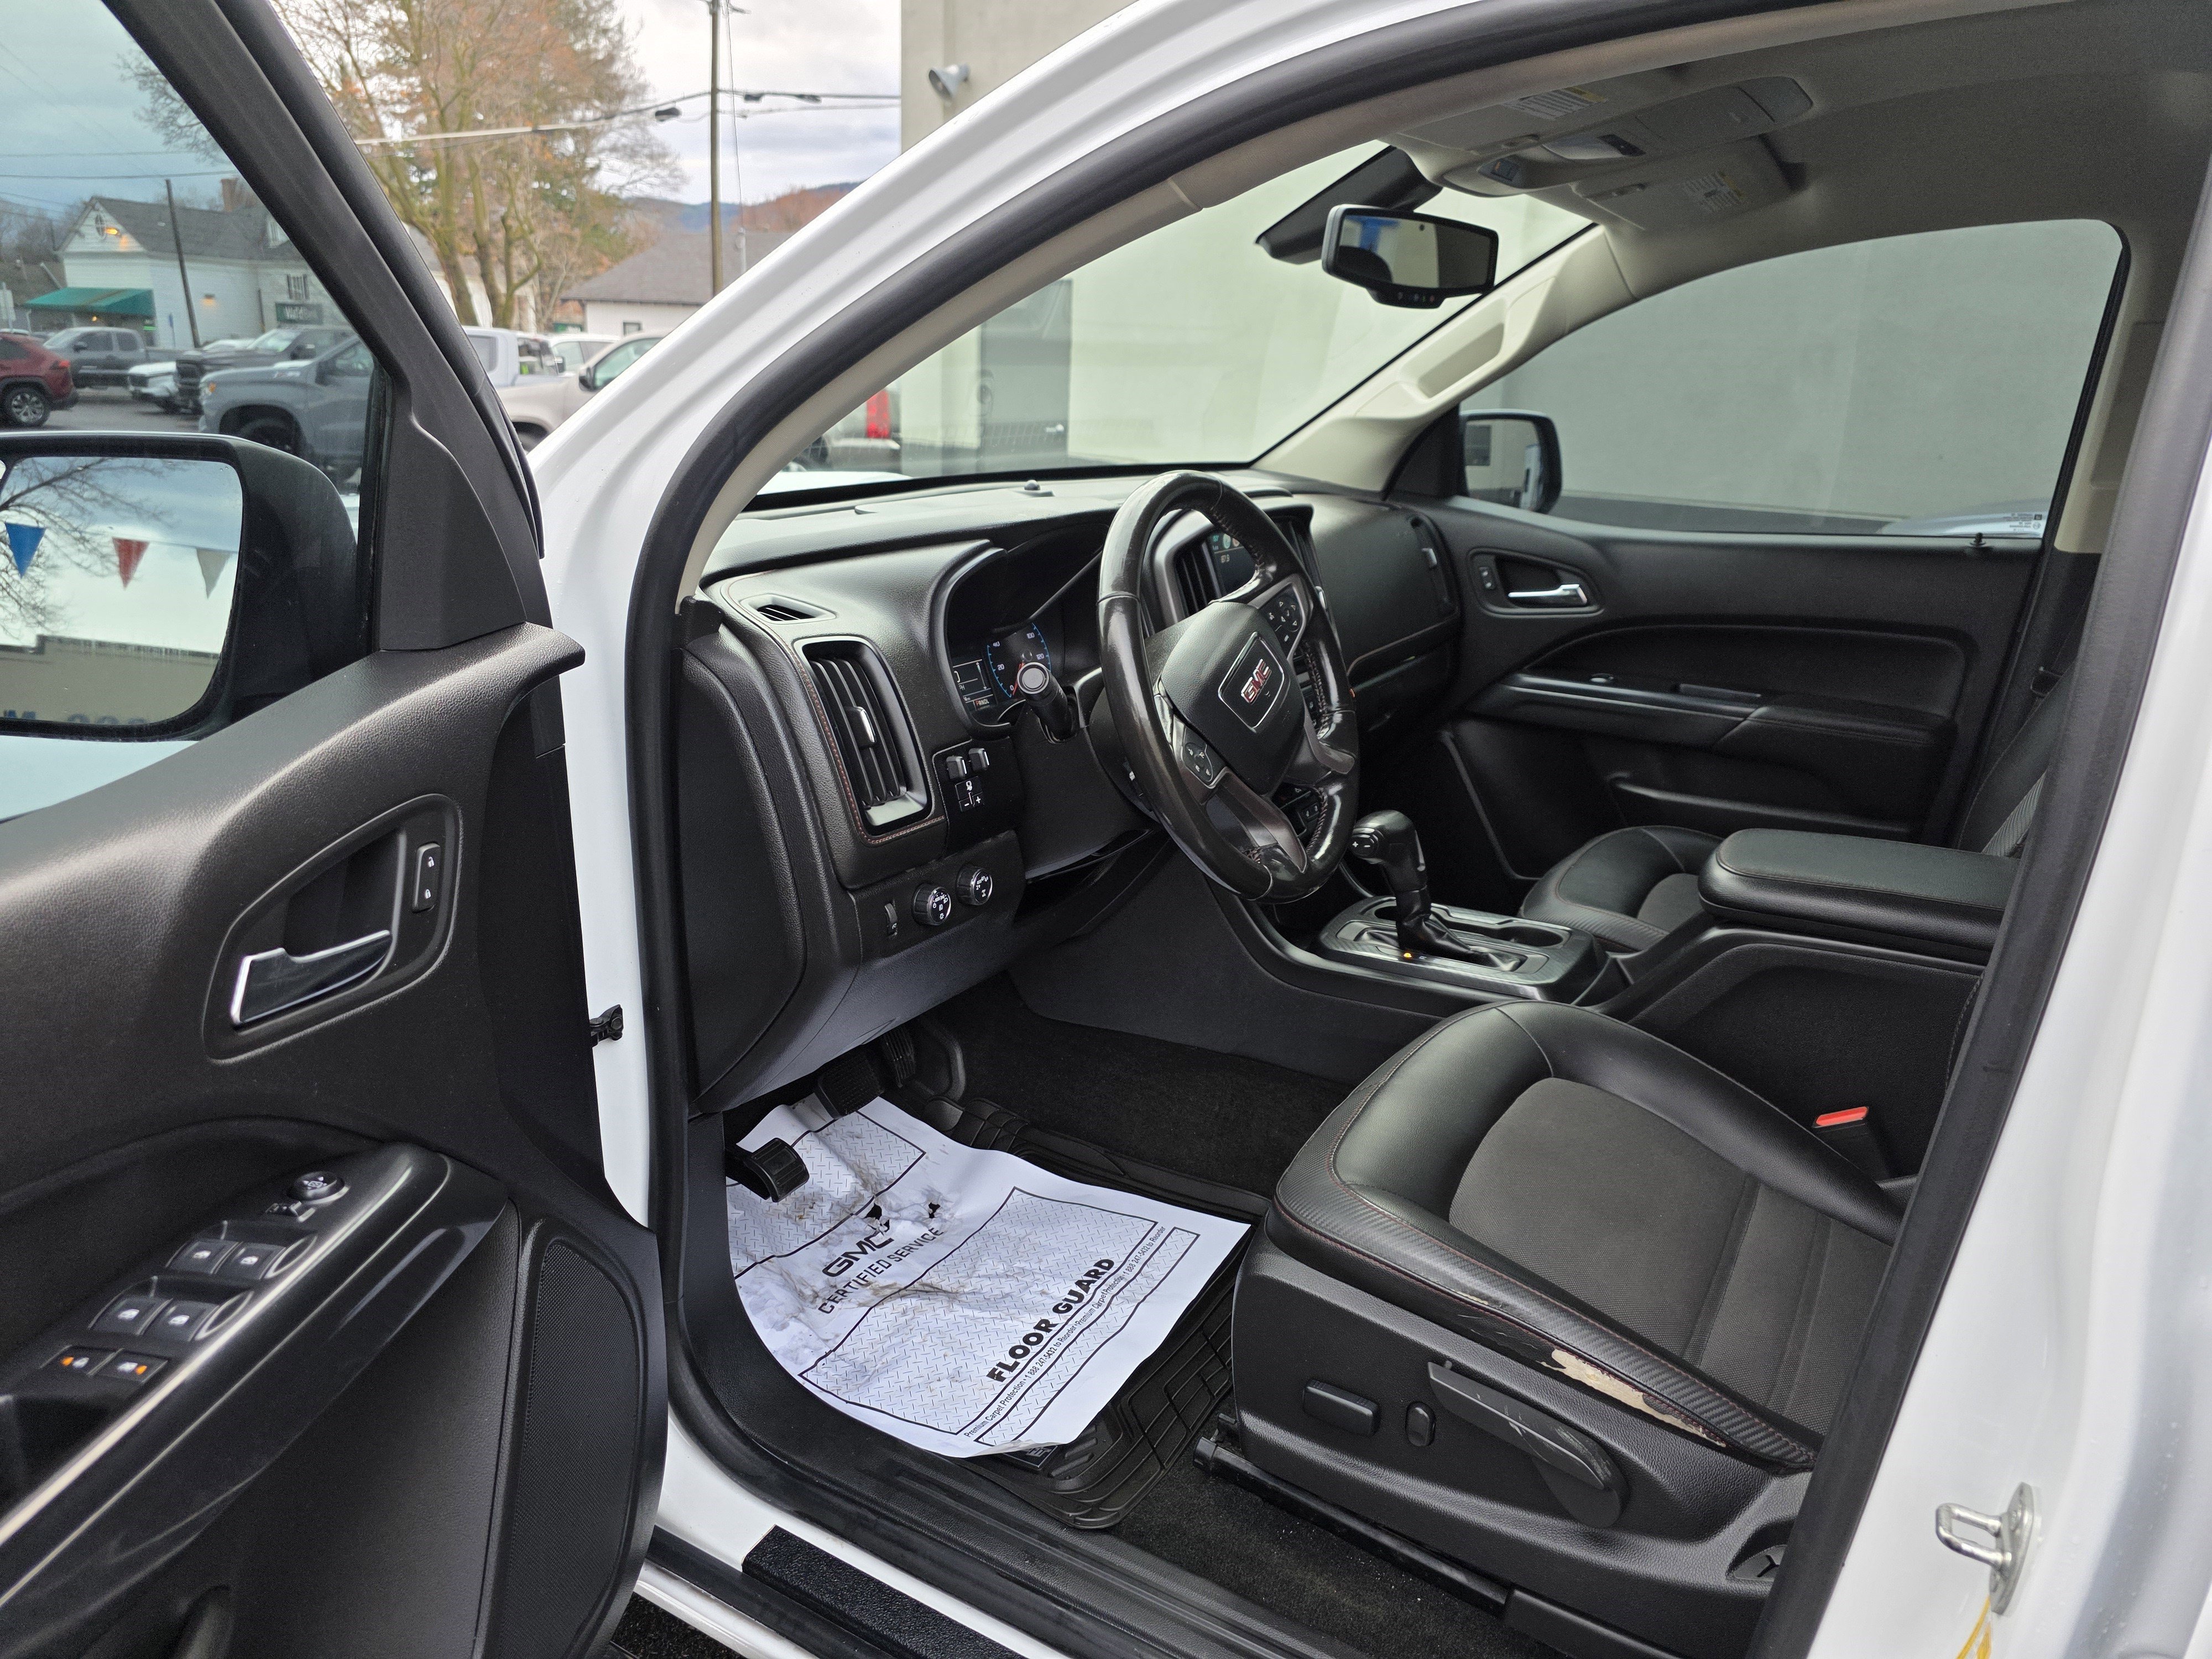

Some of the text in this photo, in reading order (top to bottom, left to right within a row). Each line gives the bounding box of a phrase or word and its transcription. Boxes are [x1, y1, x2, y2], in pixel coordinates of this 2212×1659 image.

[818, 1227, 945, 1314] CERTIFIED SERVICE
[963, 1418, 989, 1438] Premium
[985, 1402, 1005, 1422] Carpet
[1000, 1381, 1024, 1407] Protection
[1027, 1366, 1040, 1376] 888
[1036, 1347, 1057, 1368] 247-5432
[1058, 1325, 1077, 1343] Reorder
[1075, 1307, 1097, 1326] Premium
[1092, 1290, 1108, 1309] Carpet
[1104, 1275, 1124, 1295] Protection
[1125, 1262, 1136, 1272] 888
[1131, 1246, 1149, 1265] 247-5432
[1149, 1226, 1166, 1244] Reorder
[986, 1318, 1060, 1383] FLOOR
[1052, 1259, 1115, 1314] GUARD
